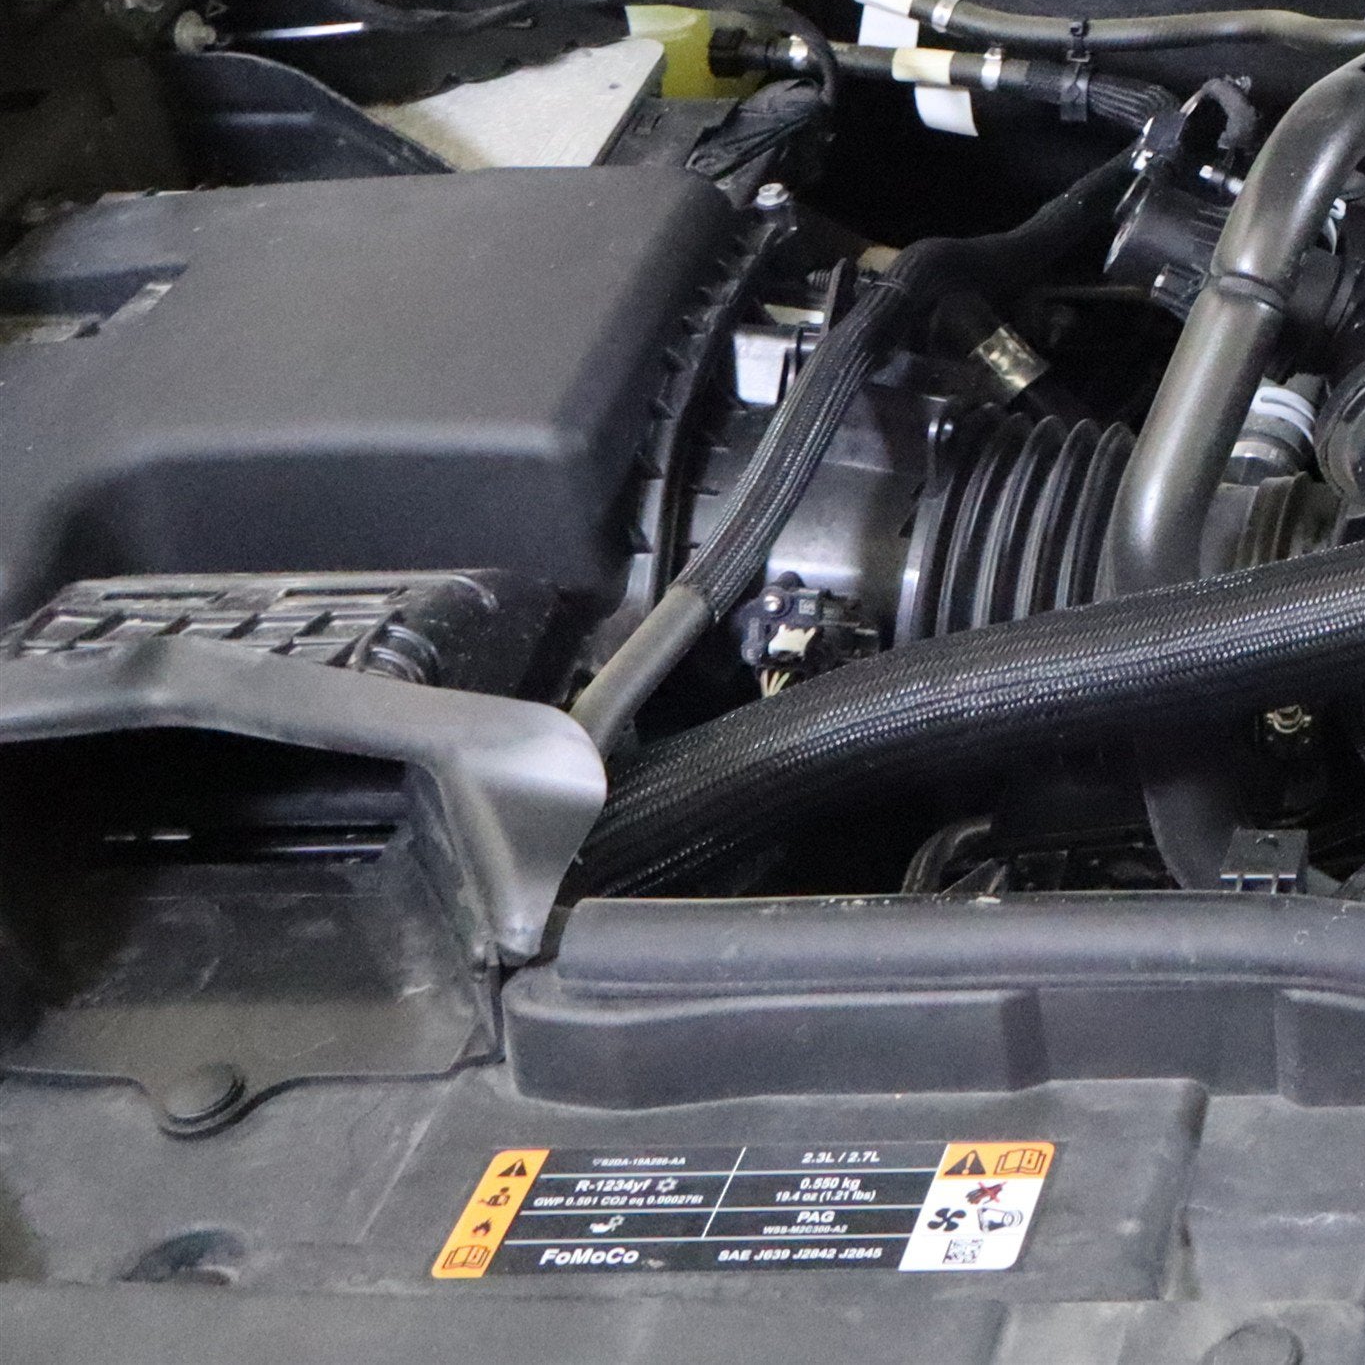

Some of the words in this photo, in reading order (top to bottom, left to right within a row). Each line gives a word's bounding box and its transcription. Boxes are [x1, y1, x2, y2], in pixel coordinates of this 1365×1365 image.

[801, 1151, 834, 1164] 2.3L
[837, 1151, 846, 1163] /
[847, 1150, 881, 1163] 2.7L
[575, 1178, 653, 1194] R-1234yf
[800, 1177, 840, 1190] 0.550
[841, 1177, 862, 1191] kg
[533, 1196, 565, 1207] GWP
[628, 1196, 645, 1207] eq
[802, 1192, 818, 1202] oz
[819, 1190, 850, 1203] (1.21
[851, 1189, 877, 1203] lbs)
[796, 1210, 836, 1223] PAG
[539, 1247, 640, 1266] FoMoCo
[717, 1248, 752, 1261] SAE
[753, 1248, 791, 1261] J639
[792, 1247, 837, 1260] J2842
[838, 1247, 884, 1260] J2845
